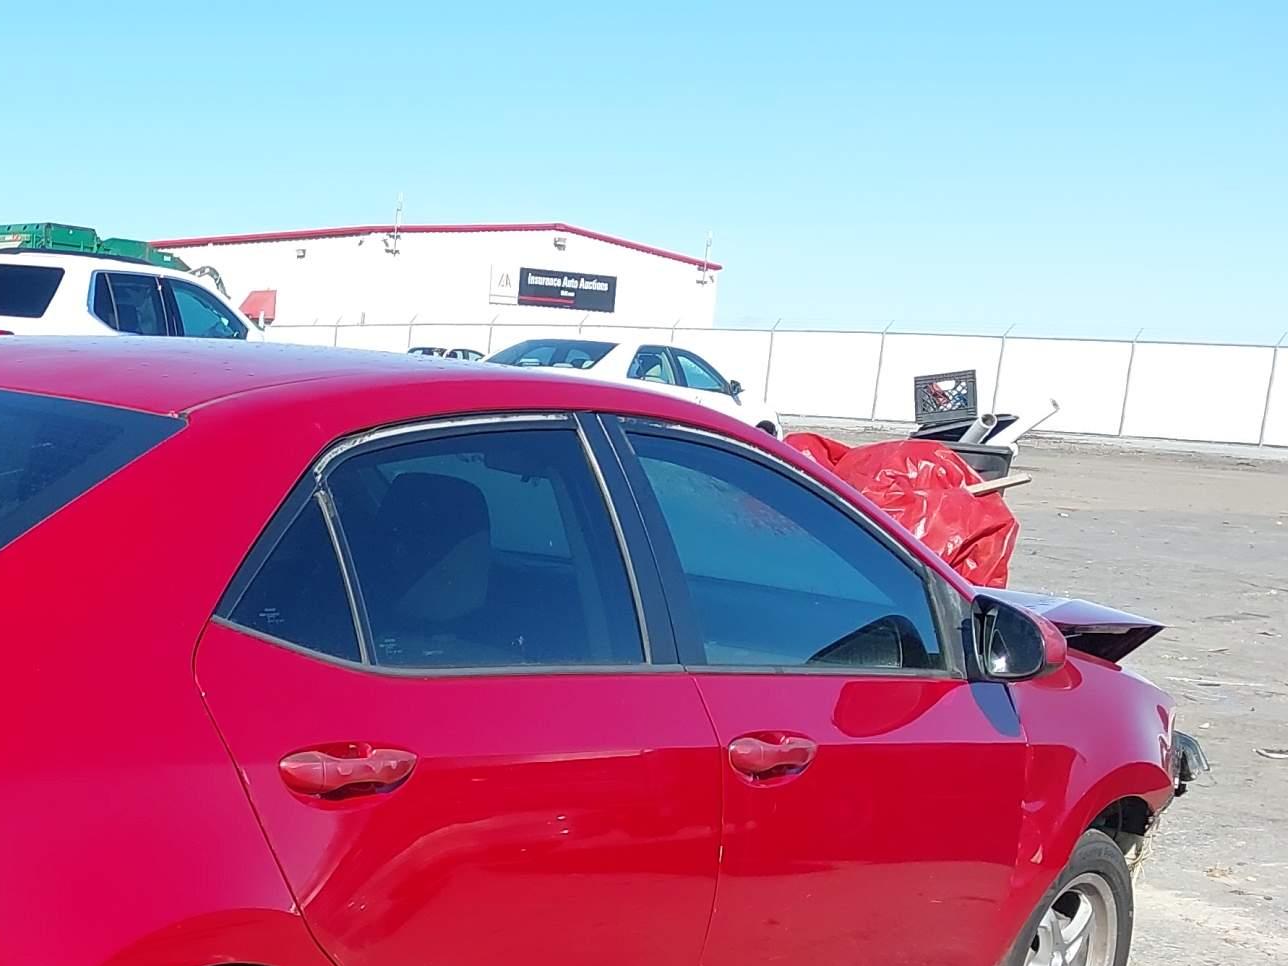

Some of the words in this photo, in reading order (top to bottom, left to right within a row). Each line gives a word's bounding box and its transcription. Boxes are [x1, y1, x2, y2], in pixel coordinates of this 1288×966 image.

[527, 273, 561, 288] Insurance
[561, 276, 578, 289] Auto
[578, 277, 608, 291] Auctions
